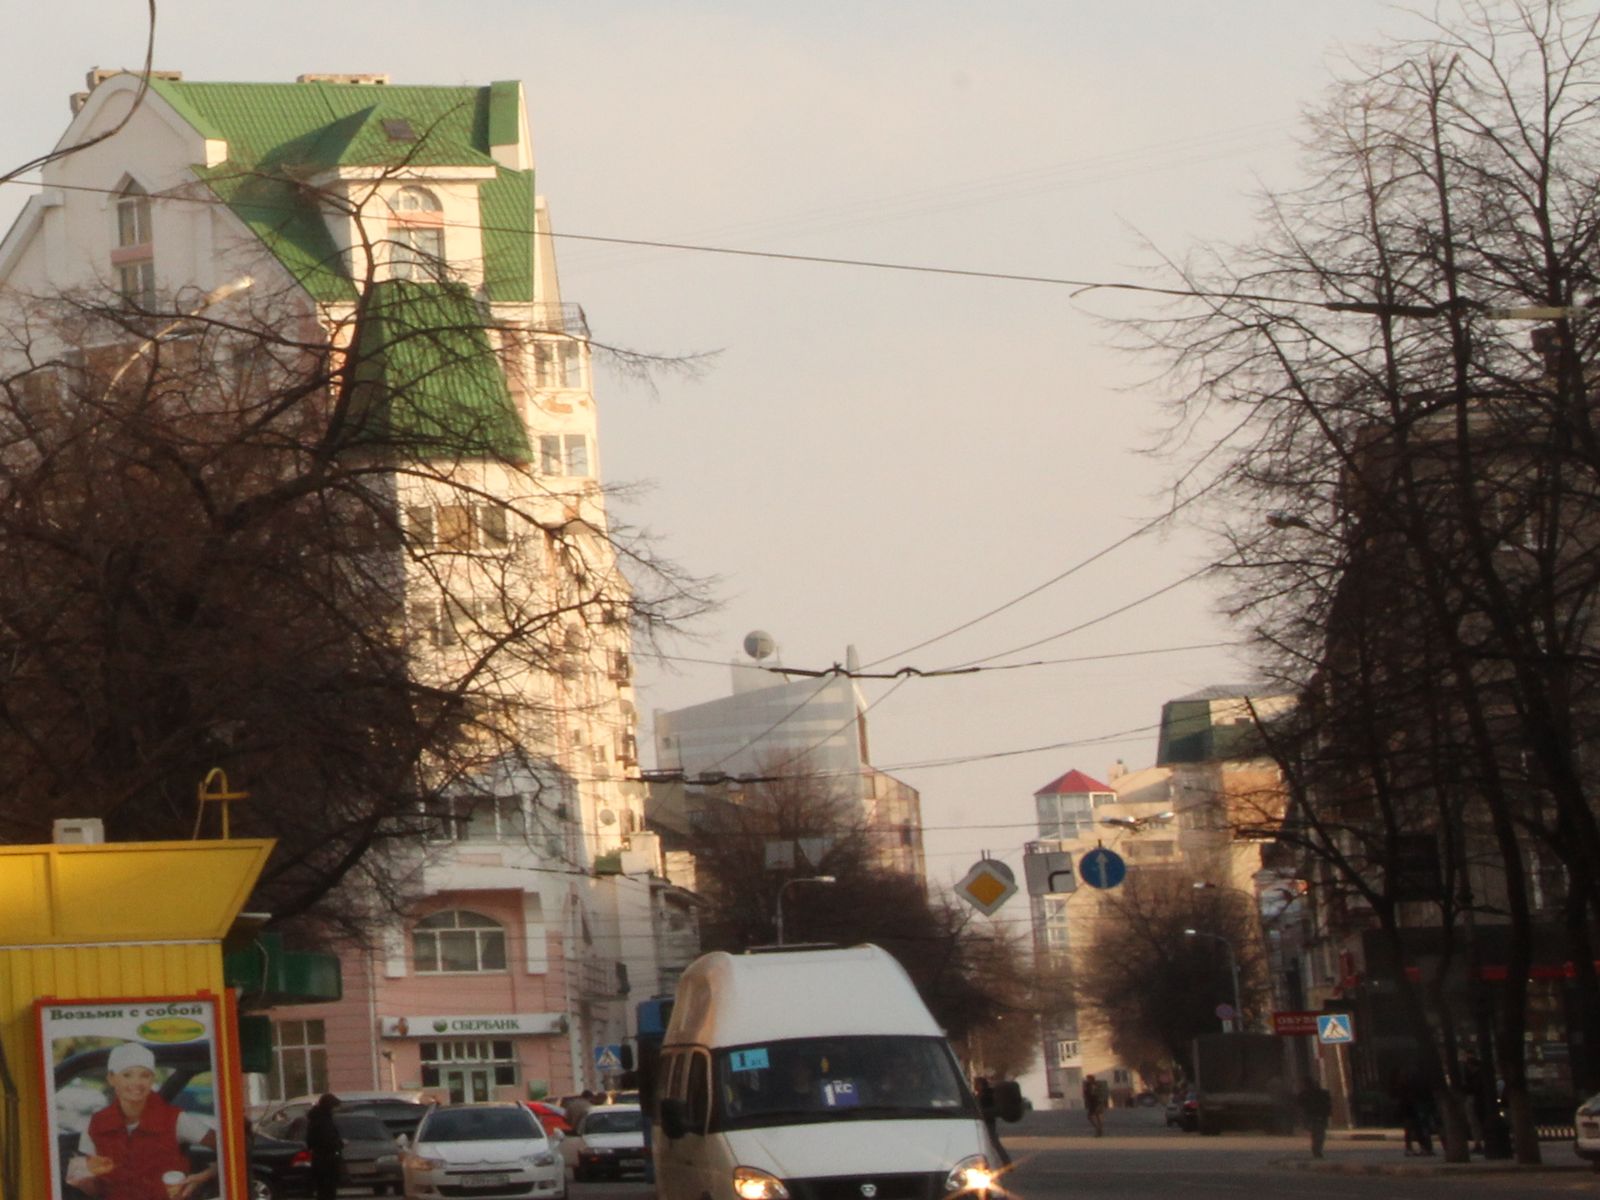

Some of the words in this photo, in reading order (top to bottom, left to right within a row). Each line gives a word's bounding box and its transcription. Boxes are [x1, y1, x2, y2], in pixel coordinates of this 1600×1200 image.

[51, 1009, 123, 1020] Возьми
[129, 1008, 139, 1018] с
[145, 1003, 204, 1017] собой
[451, 1019, 520, 1031] СБЕРБАНК
